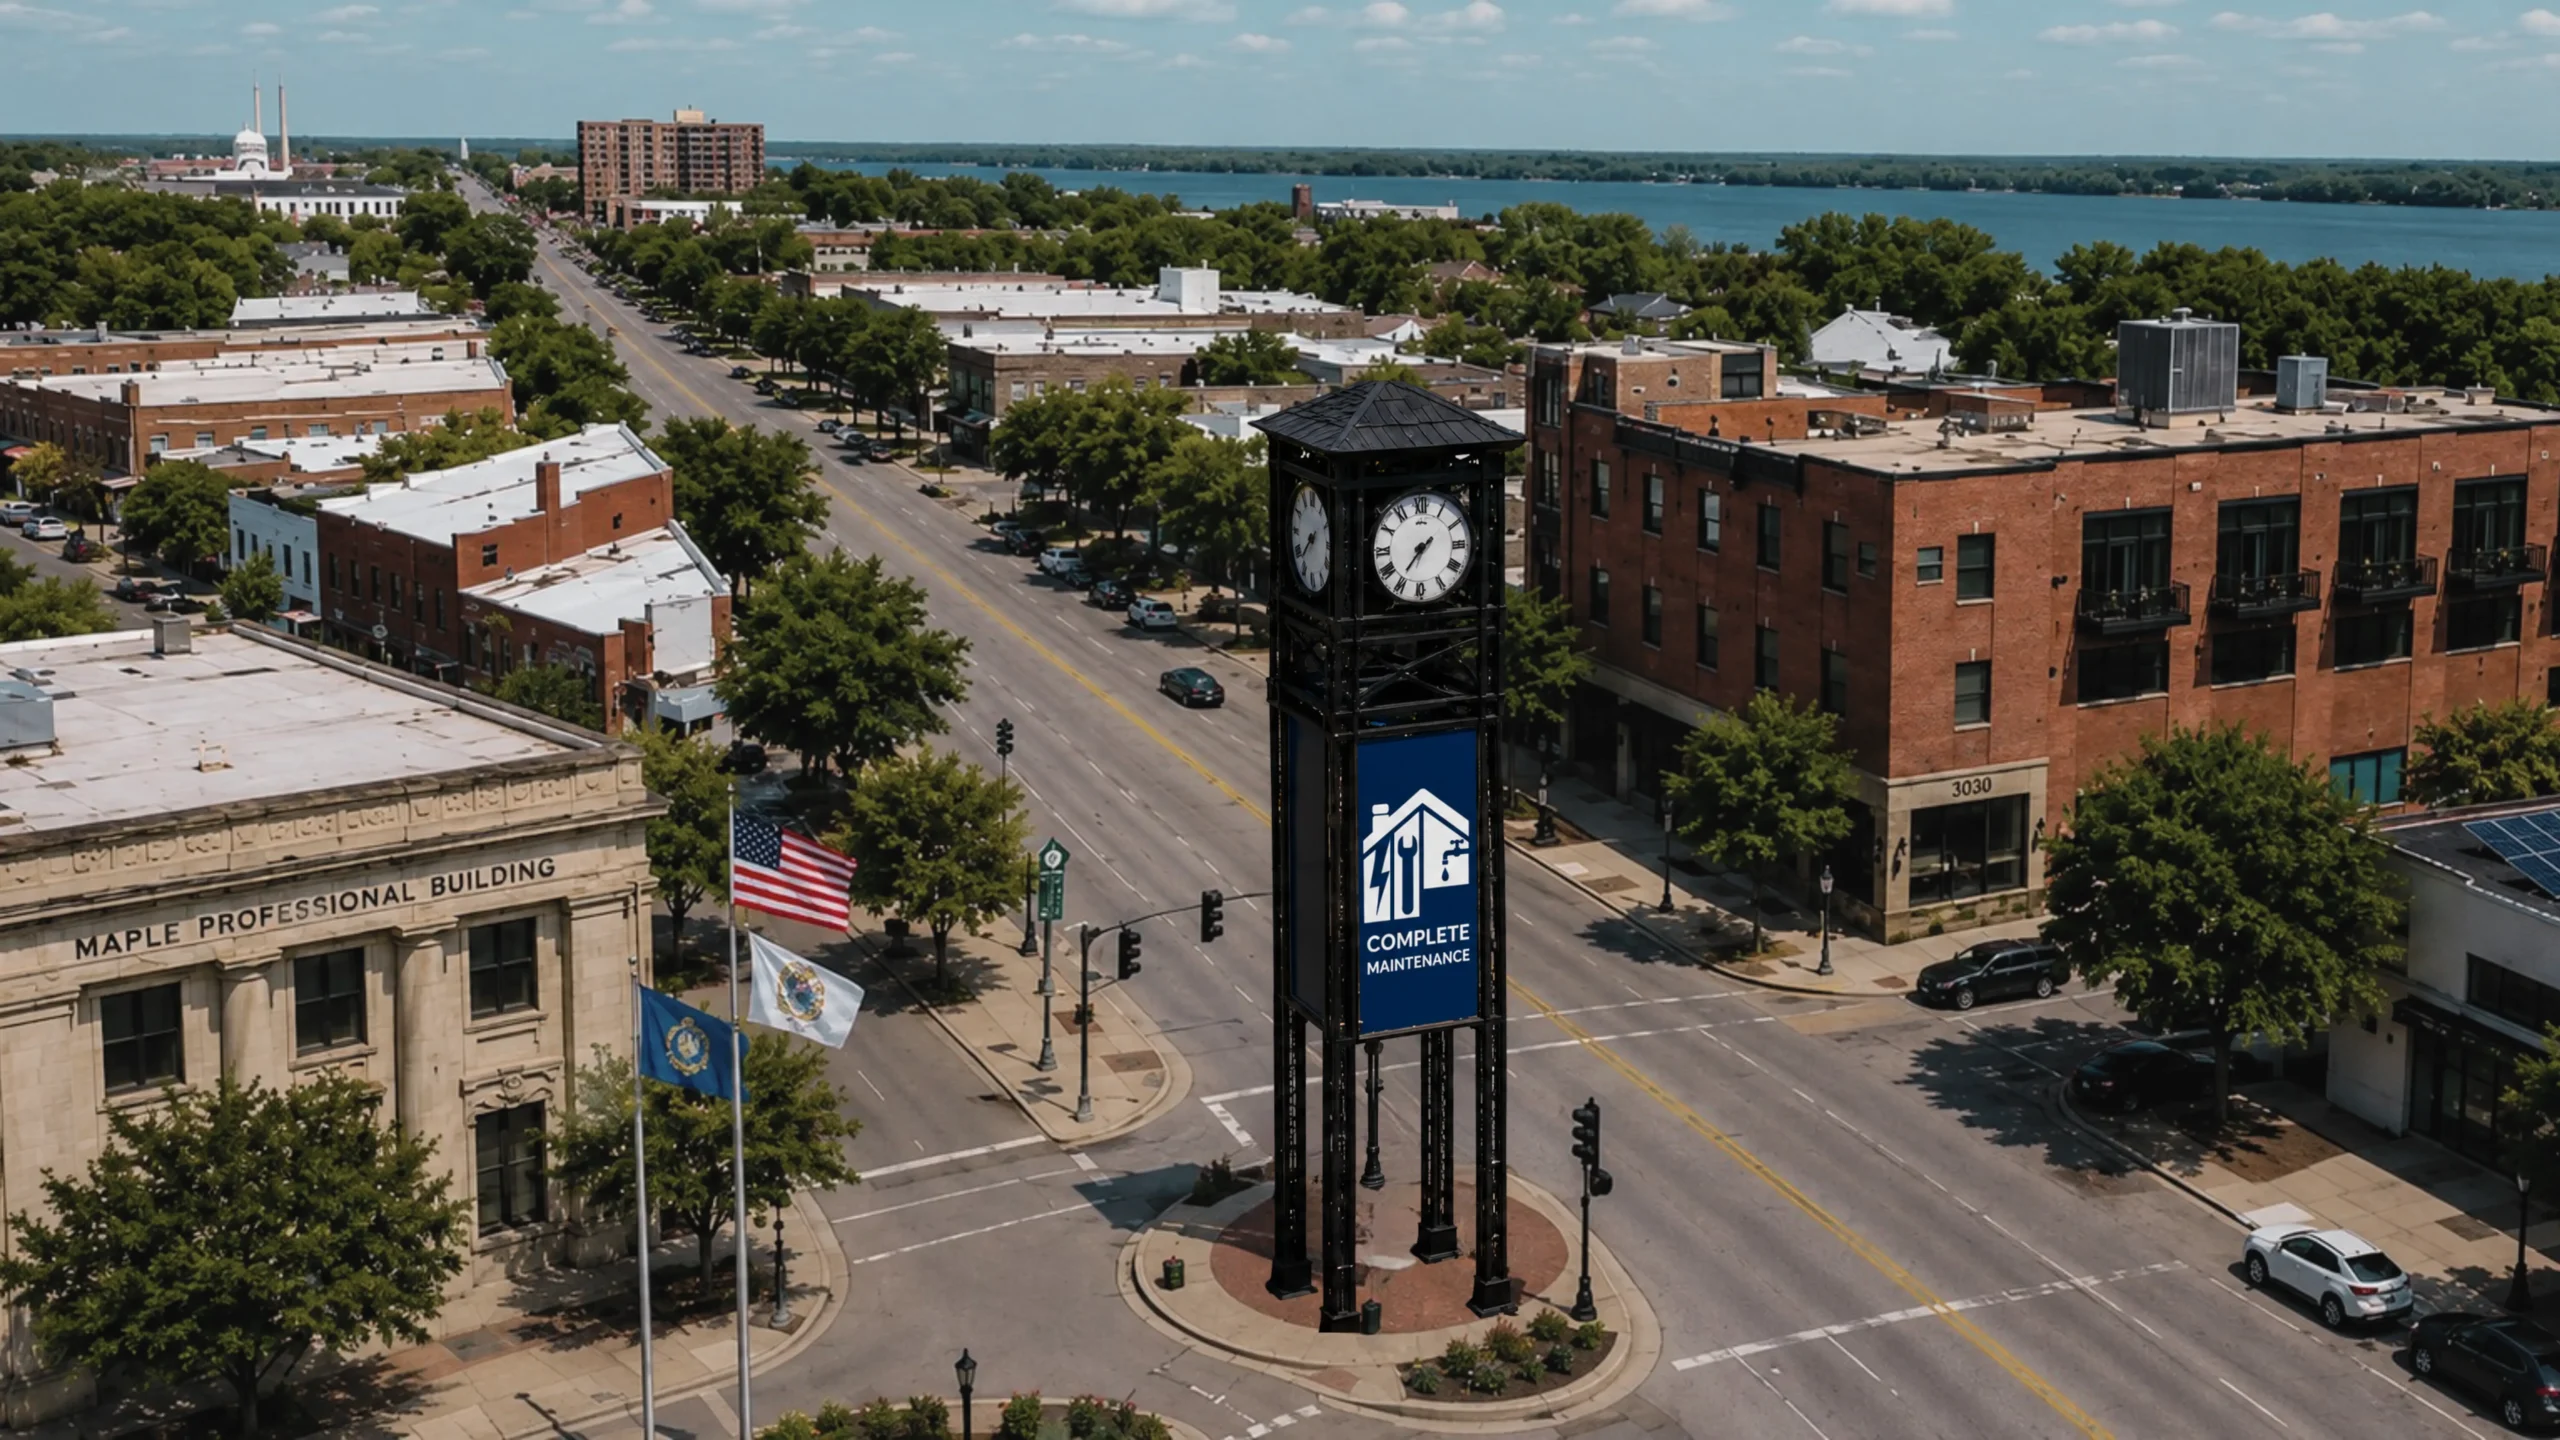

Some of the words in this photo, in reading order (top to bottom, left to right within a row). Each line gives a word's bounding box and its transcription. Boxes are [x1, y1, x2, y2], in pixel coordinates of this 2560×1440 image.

[1952, 777, 1991, 797] 3030
[75, 922, 180, 960] MAPLE
[199, 882, 416, 938] PROFESSIONAL
[431, 858, 555, 898] BUILDING
[1366, 923, 1470, 952] COMPLETE
[1367, 948, 1470, 975] MAINTENANCE
